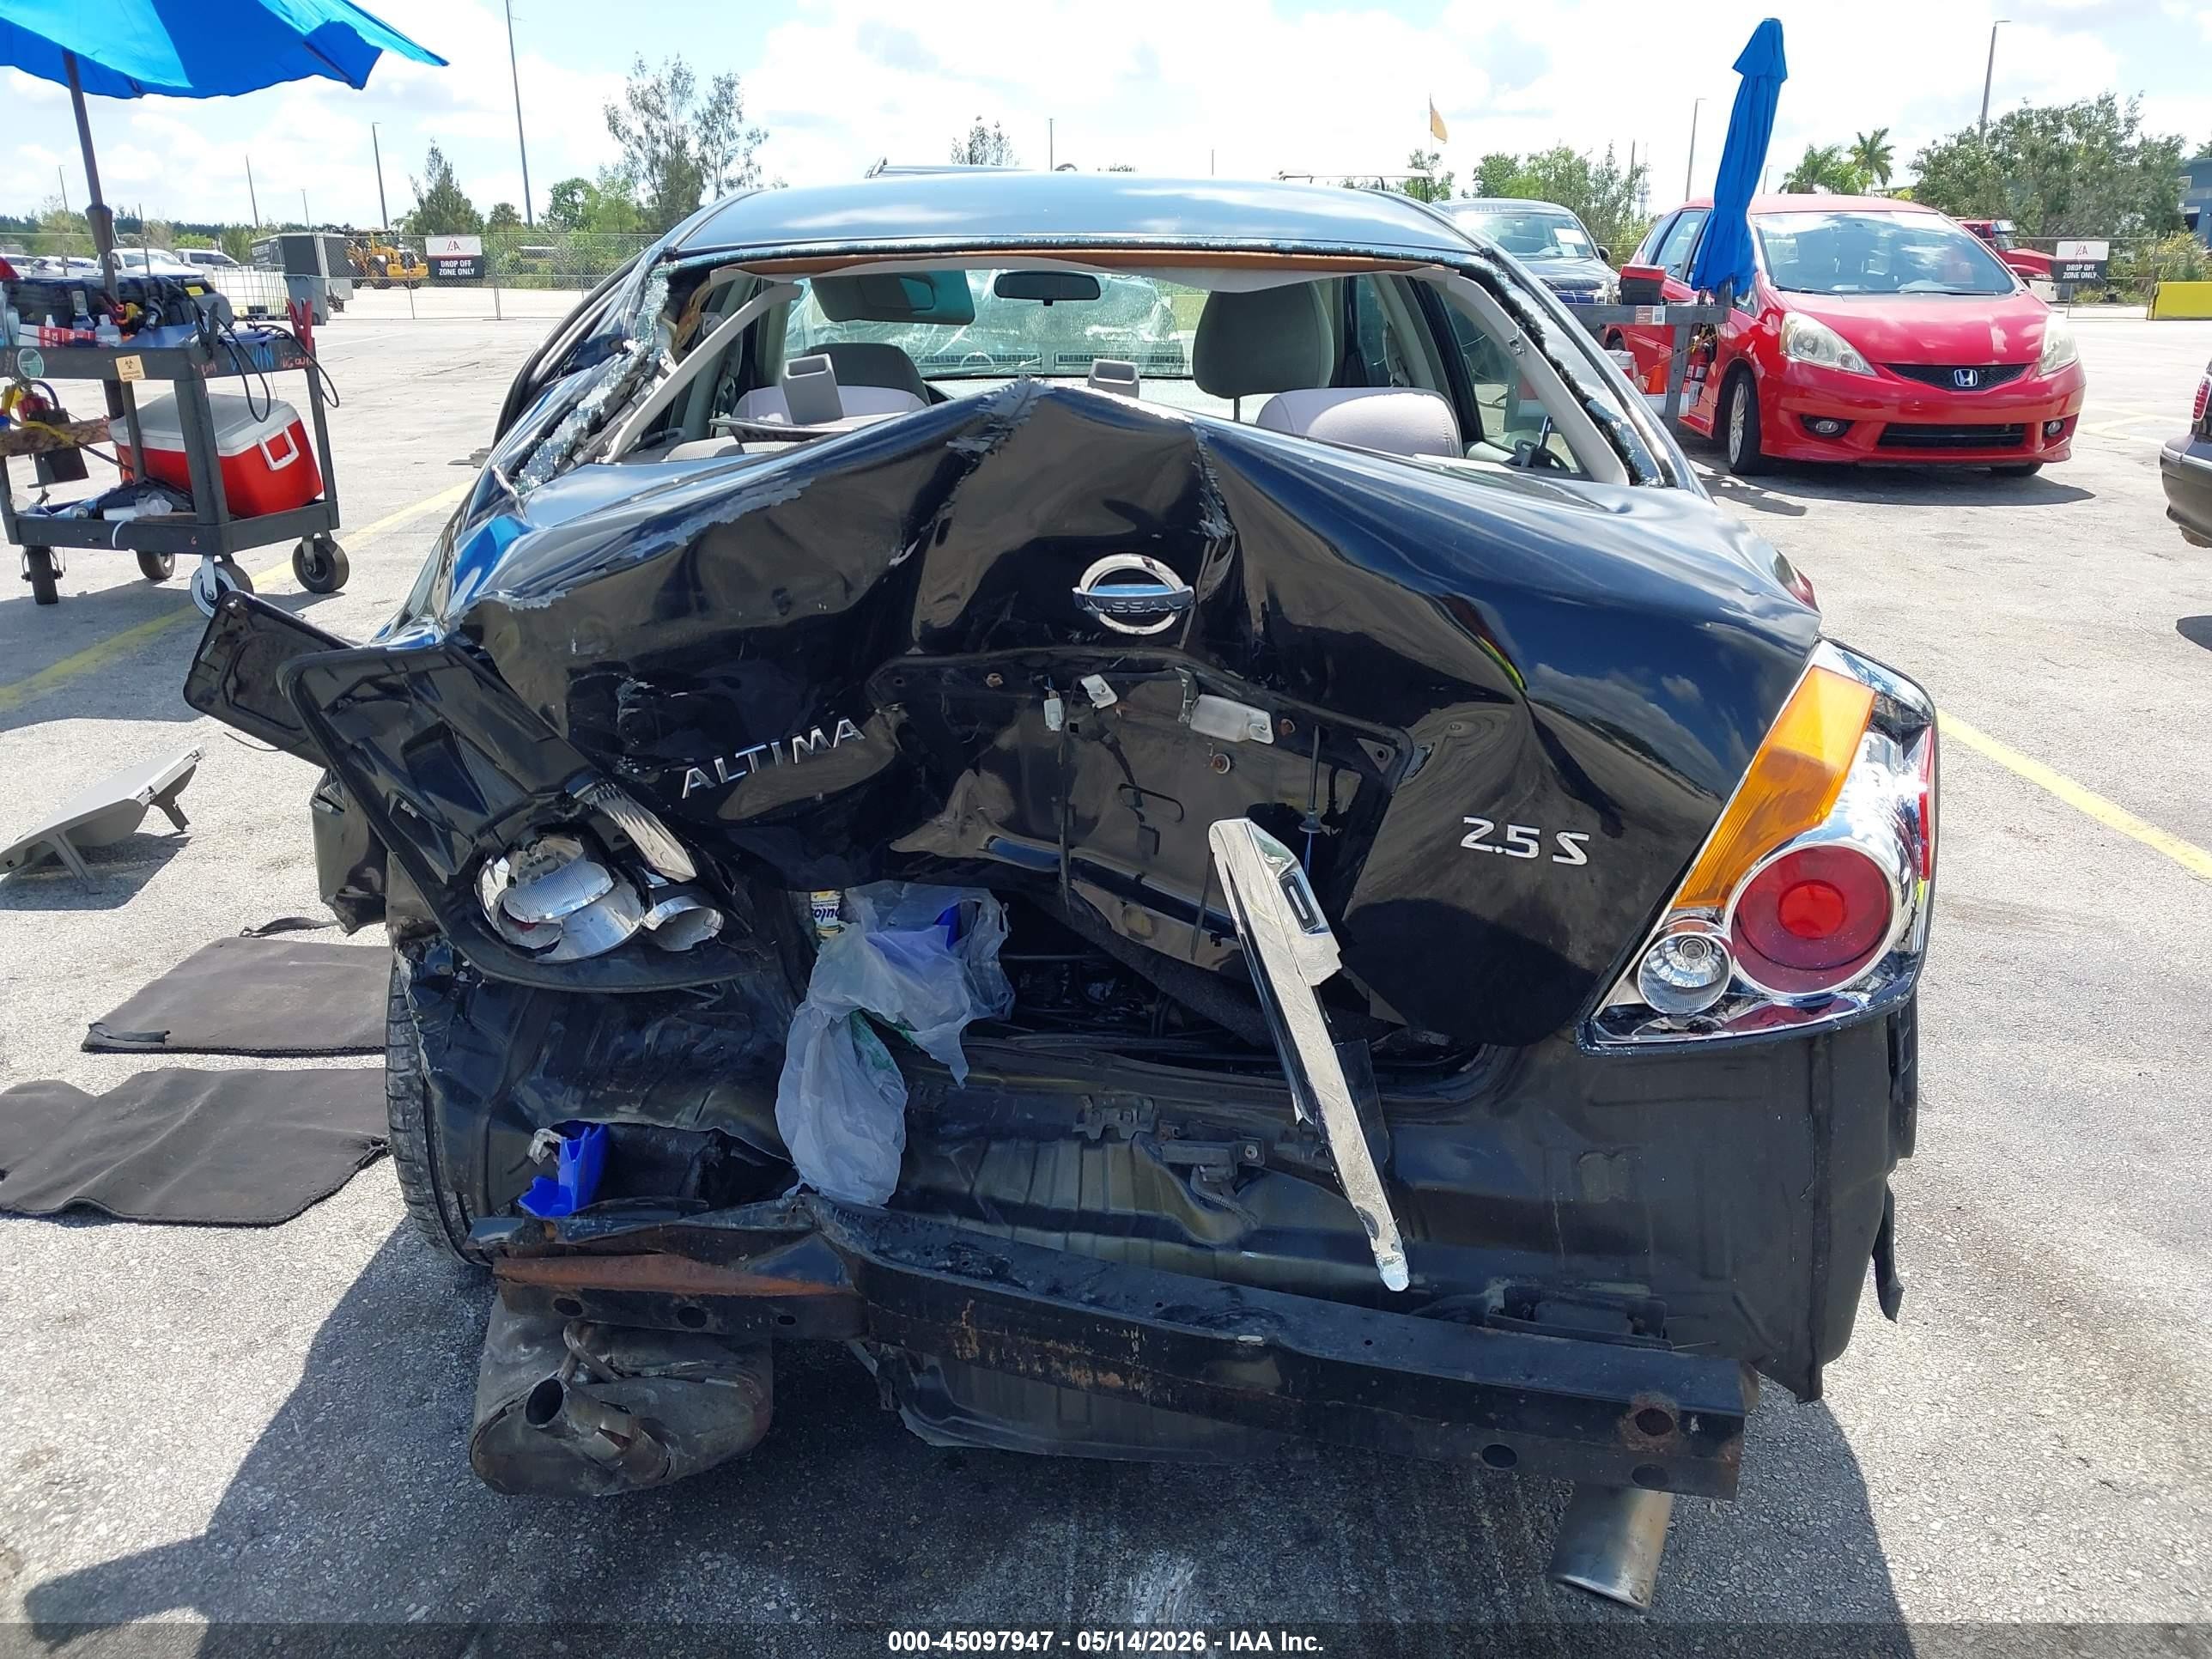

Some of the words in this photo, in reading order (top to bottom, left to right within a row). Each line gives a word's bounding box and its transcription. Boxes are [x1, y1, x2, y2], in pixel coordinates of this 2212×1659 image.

[1086, 599, 1182, 613] NISSAN
[681, 716, 866, 799] ALTIMA
[1461, 816, 1540, 860] 2.5
[1552, 830, 1590, 866] S
